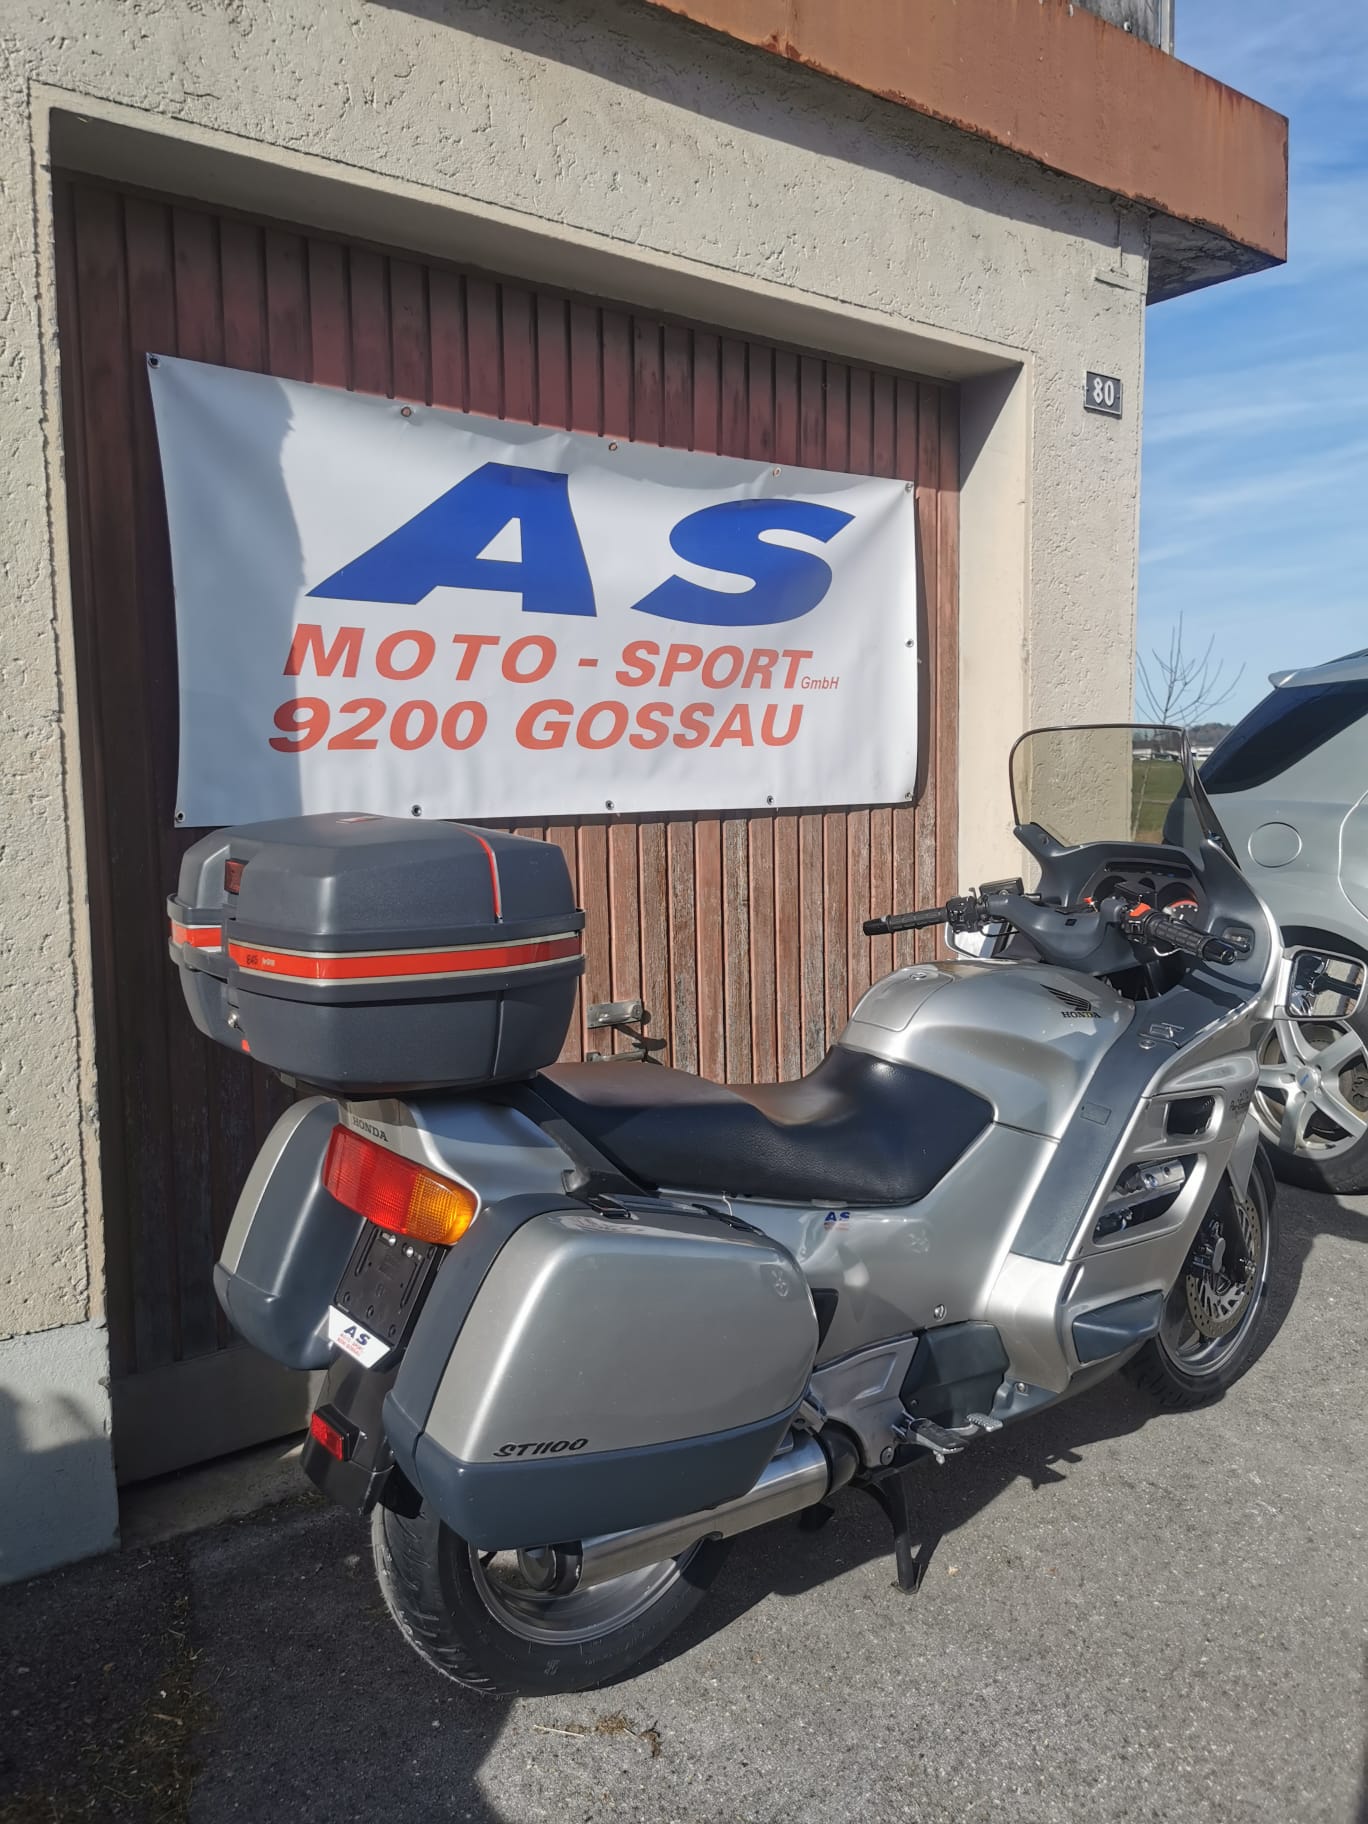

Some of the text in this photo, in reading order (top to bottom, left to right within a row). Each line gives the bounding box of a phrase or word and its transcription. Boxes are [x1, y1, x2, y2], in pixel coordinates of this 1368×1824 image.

[1093, 377, 1115, 407] 80
[283, 623, 558, 684] MOTO
[615, 640, 813, 689] SPORT
[800, 676, 840, 690] GmbH
[268, 697, 804, 753] 9200 GOSSAU
[1062, 1011, 1102, 1019] HONDA
[352, 1115, 389, 1142] HONDA
[343, 1325, 371, 1346] AS
[493, 1438, 588, 1457] ST1100
